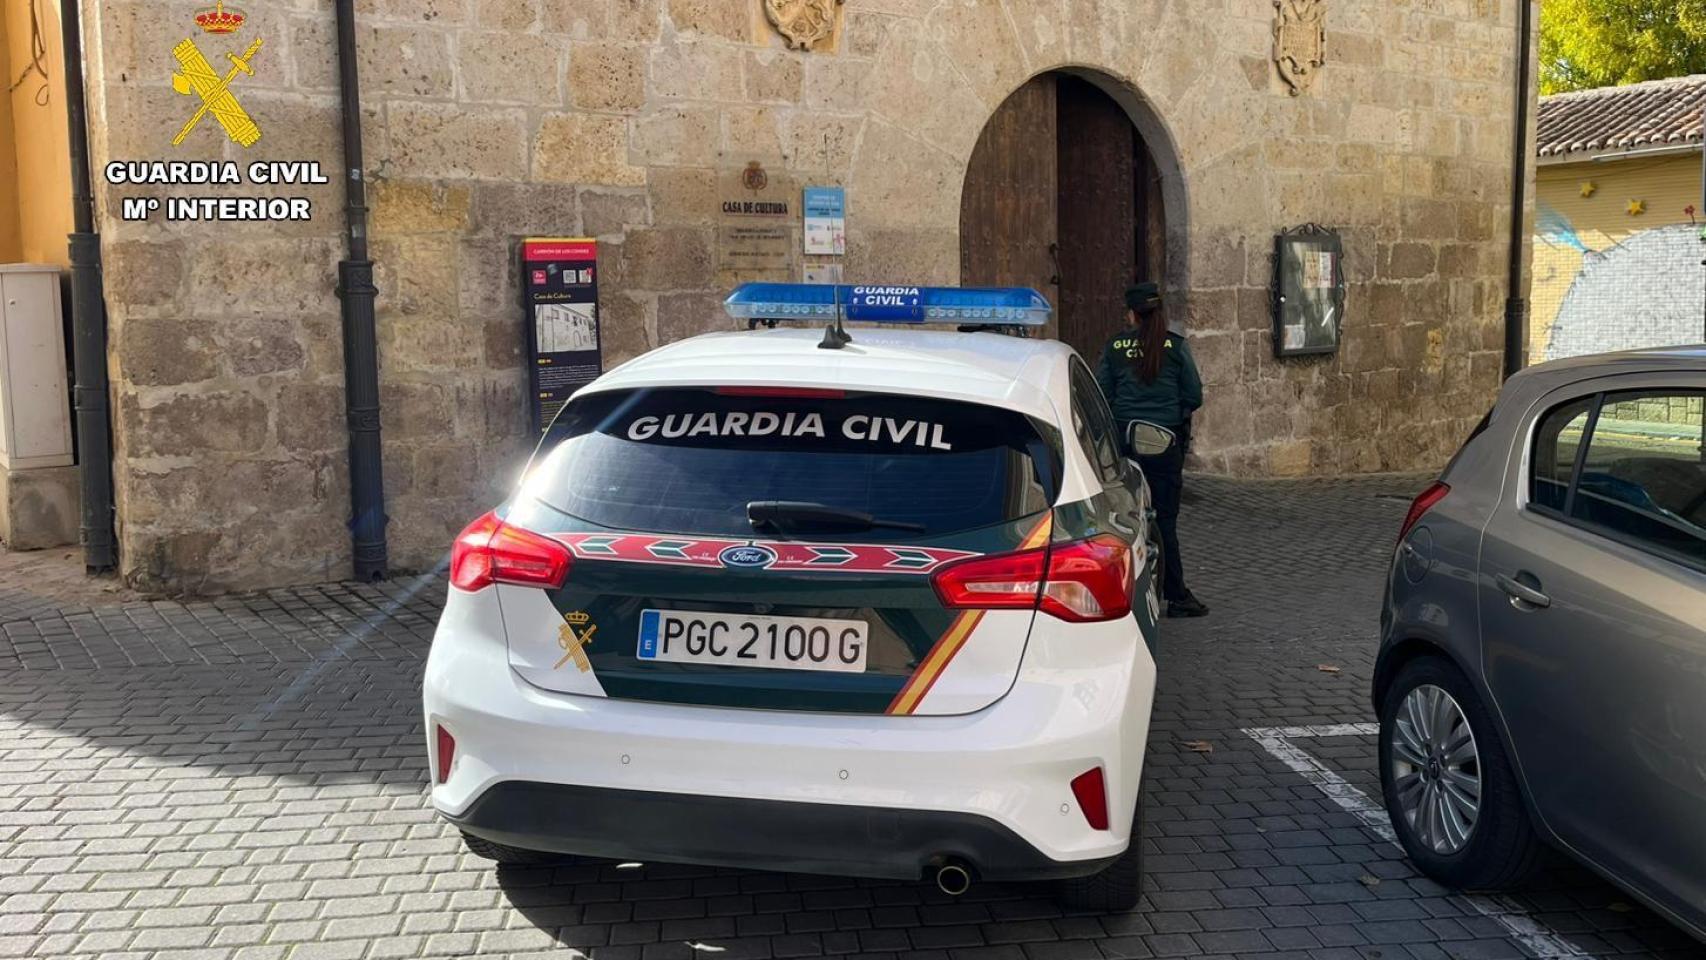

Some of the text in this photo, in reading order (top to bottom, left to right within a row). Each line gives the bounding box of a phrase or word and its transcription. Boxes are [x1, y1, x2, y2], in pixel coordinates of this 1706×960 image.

[722, 201, 788, 215] CASA DE CULTURA
[853, 286, 919, 295] GUARDIA
[865, 295, 905, 306] CIVIL
[628, 412, 952, 450] GUARDIA CIVIL
[645, 640, 652, 651] E
[662, 618, 860, 665] PGC 2100 G
